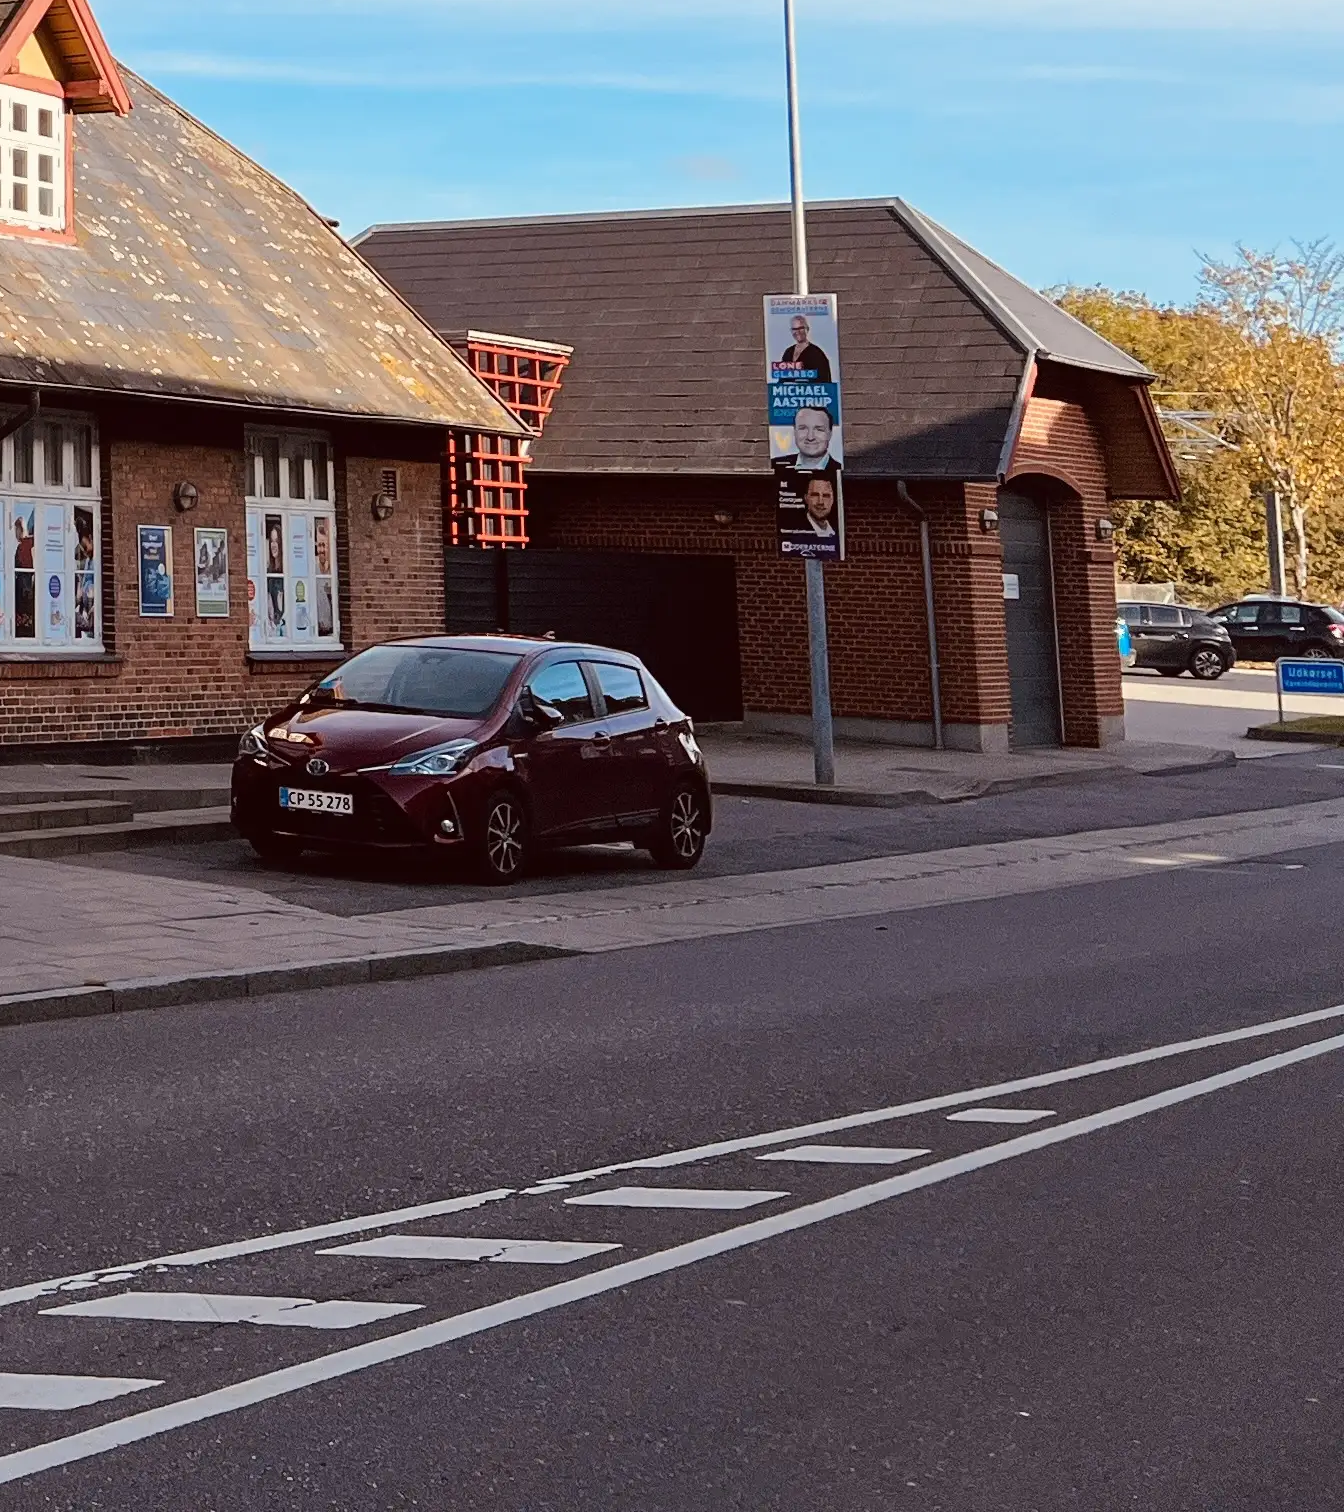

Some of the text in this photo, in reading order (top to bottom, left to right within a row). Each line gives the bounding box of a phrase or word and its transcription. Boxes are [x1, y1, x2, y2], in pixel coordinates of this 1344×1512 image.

[772, 362, 802, 370] LONE
[772, 385, 829, 396] MICHAEL
[772, 397, 833, 408] AASTRUP
[288, 791, 351, 811] CP 55 278
